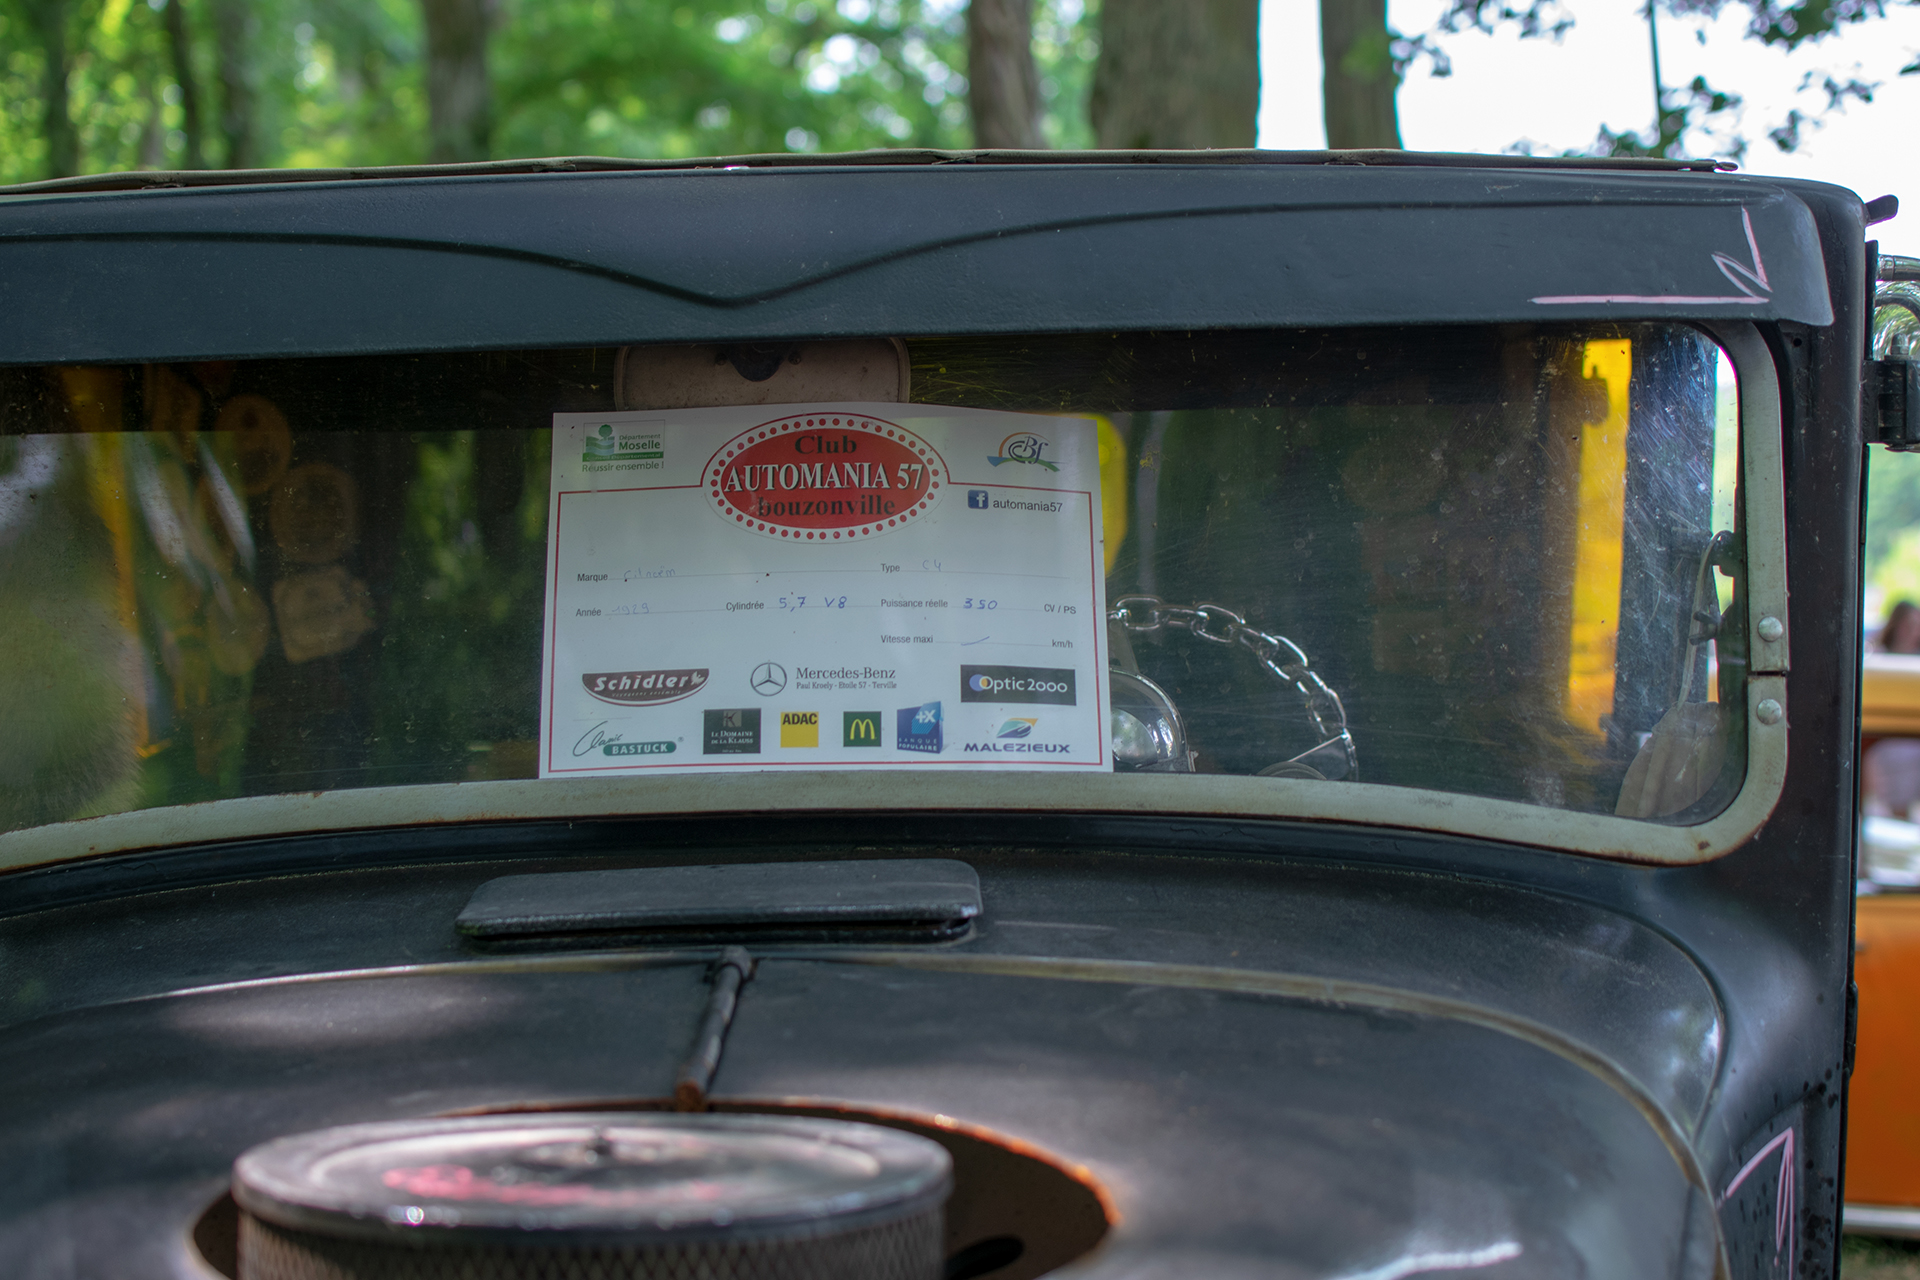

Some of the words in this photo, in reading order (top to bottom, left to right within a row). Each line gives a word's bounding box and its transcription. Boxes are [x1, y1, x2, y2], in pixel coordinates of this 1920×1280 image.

[619, 440, 661, 451] Moselle
[795, 435, 857, 454] Club
[582, 463, 614, 472] Réussir
[616, 461, 659, 471] ensemble
[724, 462, 890, 492] AUTOMANIA
[896, 463, 925, 491] 57
[758, 494, 896, 517] bouzonville
[992, 499, 1064, 513] automania57
[881, 563, 900, 574] Type
[577, 573, 608, 583] Marque
[612, 602, 650, 616] 1929
[726, 600, 764, 612] Cylindrée
[881, 598, 923, 609] Puissance
[925, 598, 949, 609] réelle
[963, 597, 998, 610] 350
[576, 607, 601, 617] Année
[880, 634, 911, 644] Vitesse
[913, 634, 934, 644] maxi
[1052, 638, 1074, 648] km/h
[796, 667, 896, 680] Mercedes-Benz
[593, 673, 688, 692] Schidler
[796, 681, 811, 690] Paul
[812, 681, 833, 691] Kroely
[858, 681, 867, 689] 57
[872, 681, 897, 689] Terville
[979, 675, 1025, 694] Optic
[782, 713, 818, 726] ADAC
[611, 743, 668, 755] BASTUCK
[898, 743, 938, 752] POPULAIRE
[963, 742, 1071, 754] MALEZIEUX
